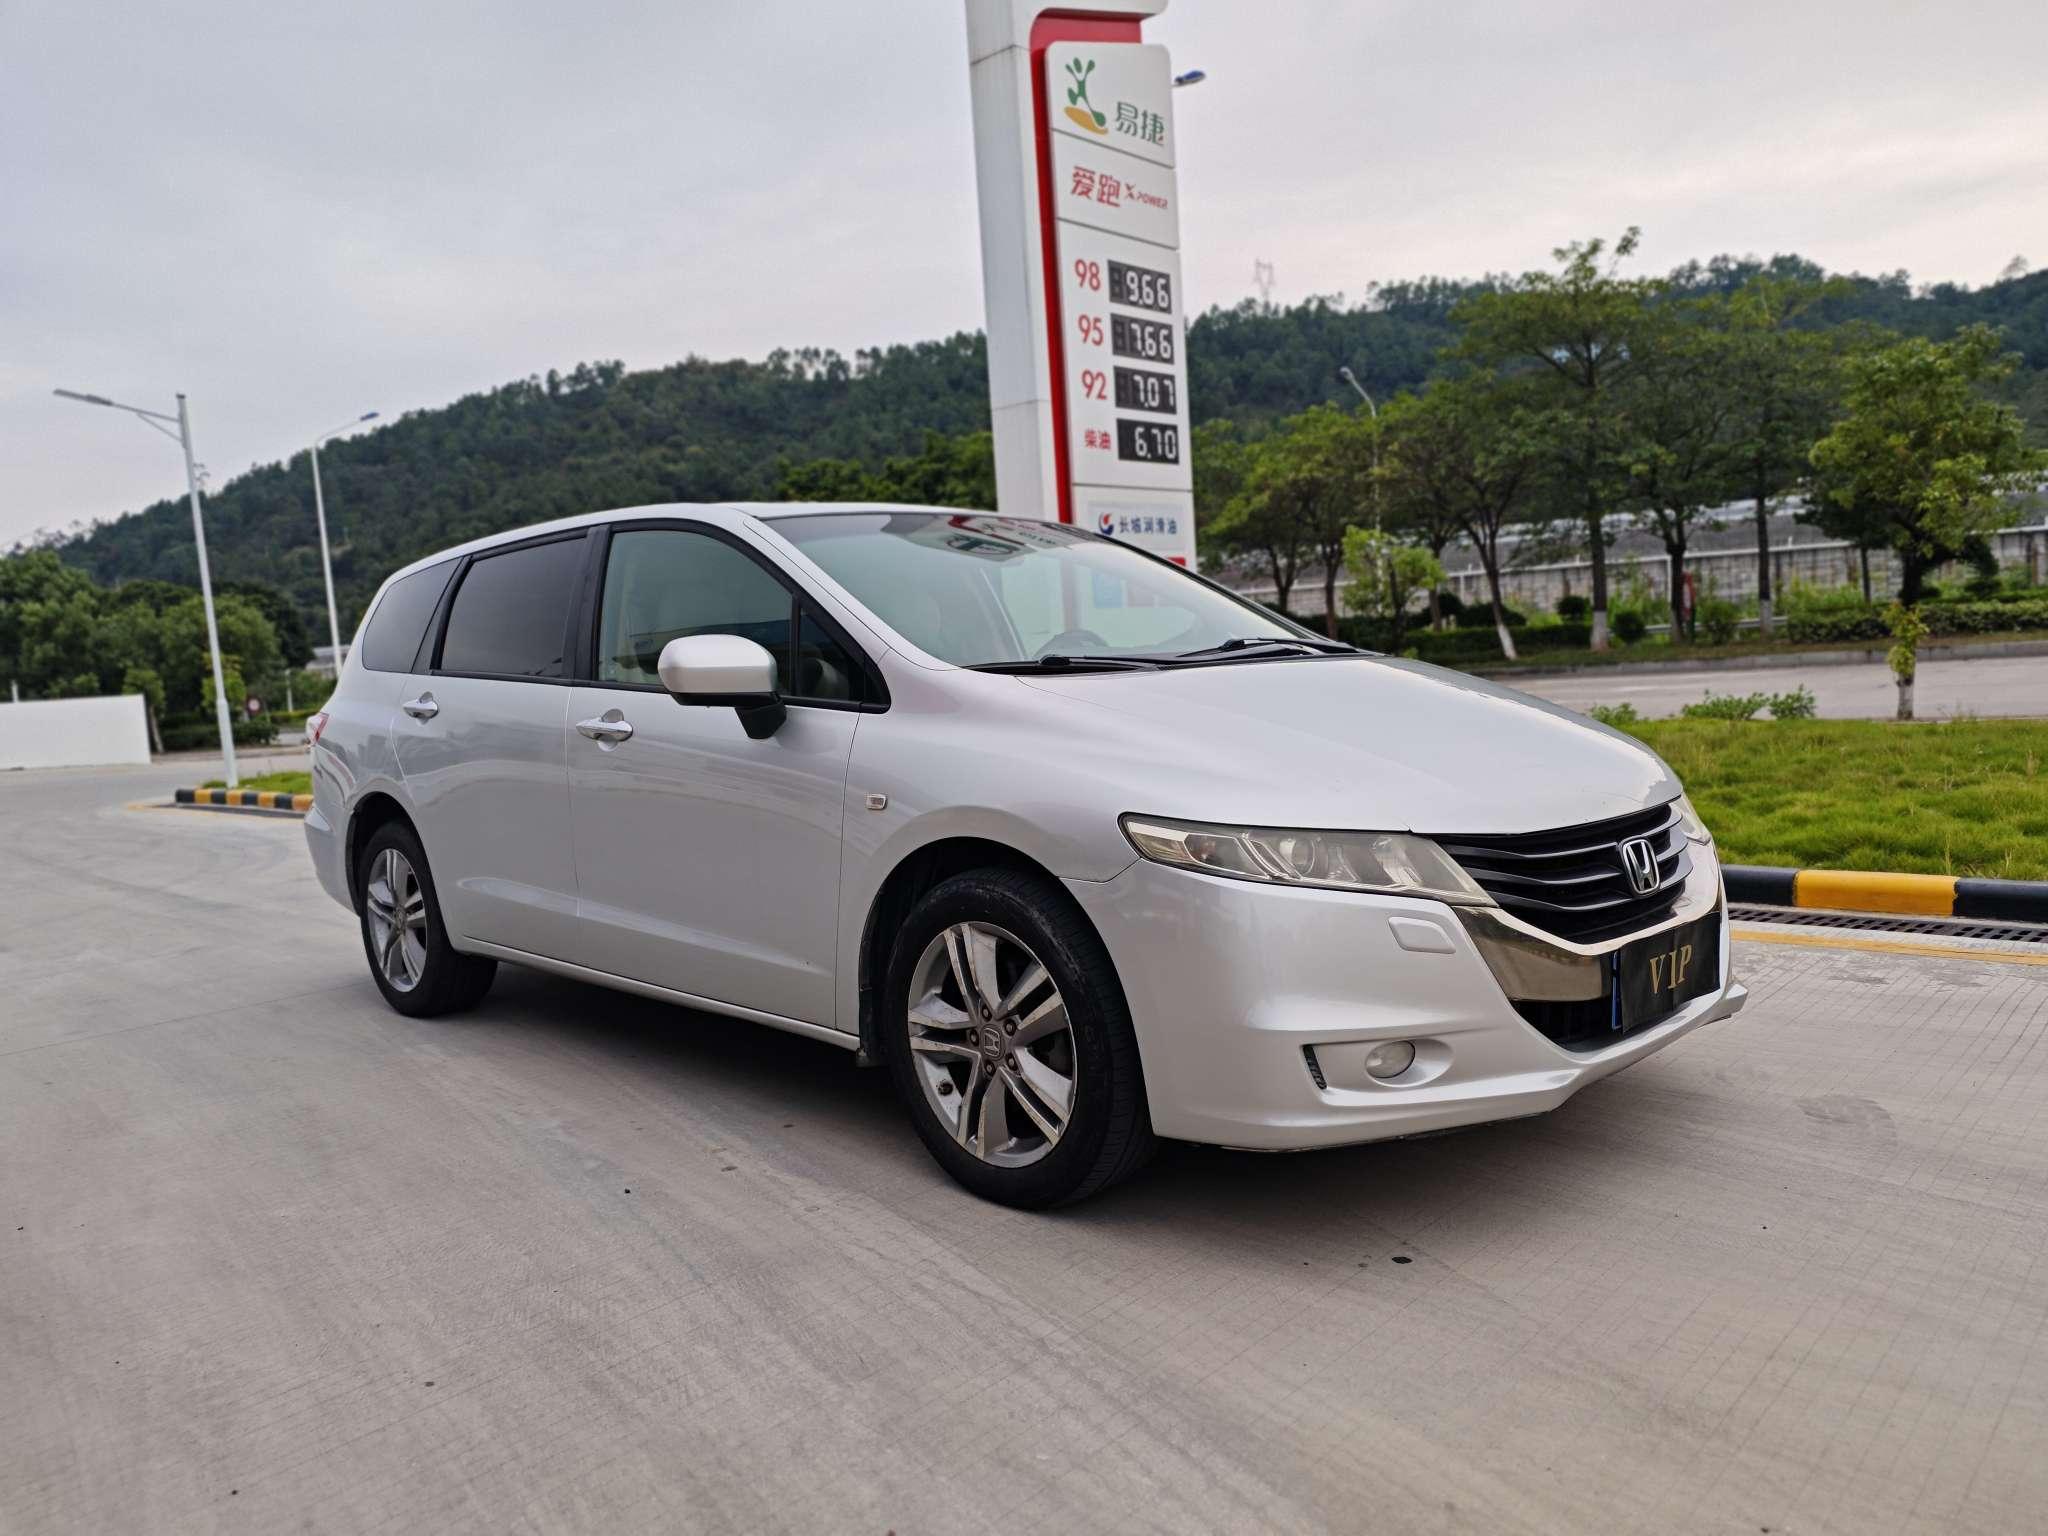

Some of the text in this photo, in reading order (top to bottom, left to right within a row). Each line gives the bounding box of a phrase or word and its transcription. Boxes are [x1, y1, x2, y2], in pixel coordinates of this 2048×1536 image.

[1115, 101, 1165, 147] 易捷
[1071, 165, 1121, 208] 爱跑
[1075, 258, 1170, 308] 98 9.66
[1078, 314, 1172, 359] 95 7.66
[1081, 369, 1174, 408] 92 7.07
[1084, 426, 1177, 459] 柴油 6.70
[1650, 944, 1693, 994] VIP
